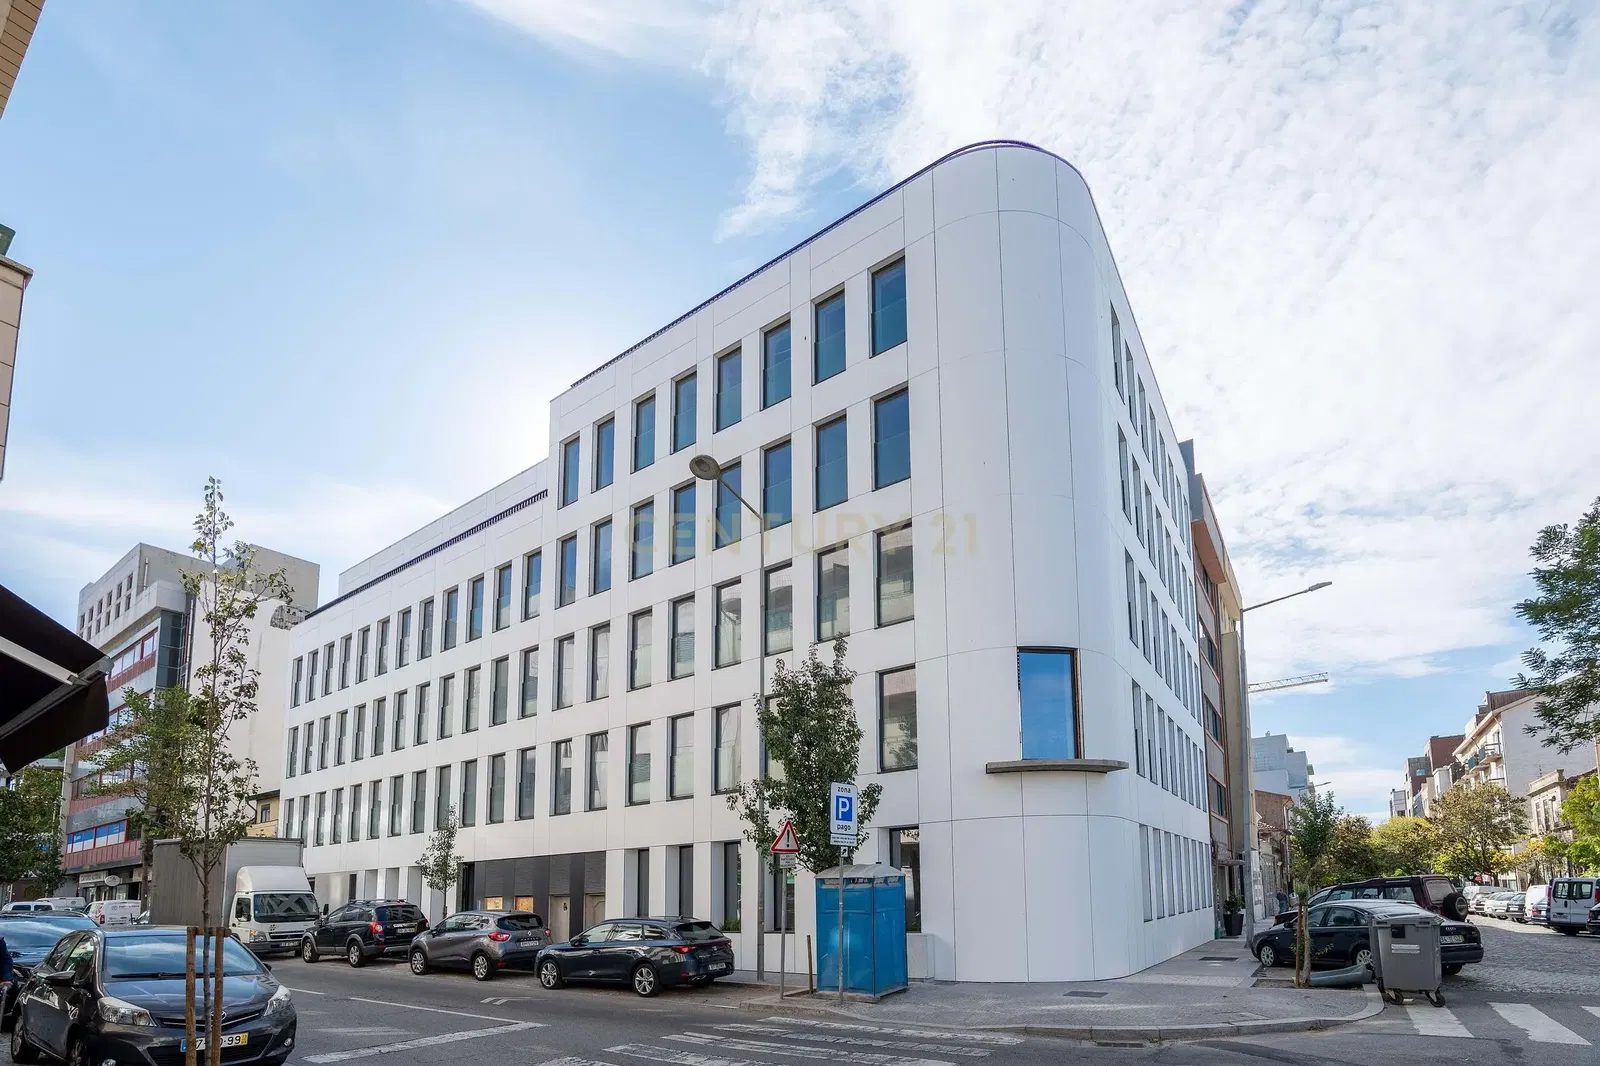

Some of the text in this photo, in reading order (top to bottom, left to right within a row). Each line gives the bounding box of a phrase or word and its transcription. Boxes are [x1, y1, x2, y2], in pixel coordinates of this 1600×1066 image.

[837, 786, 852, 794] zona
[838, 797, 850, 820] P
[836, 824, 852, 832] pago
